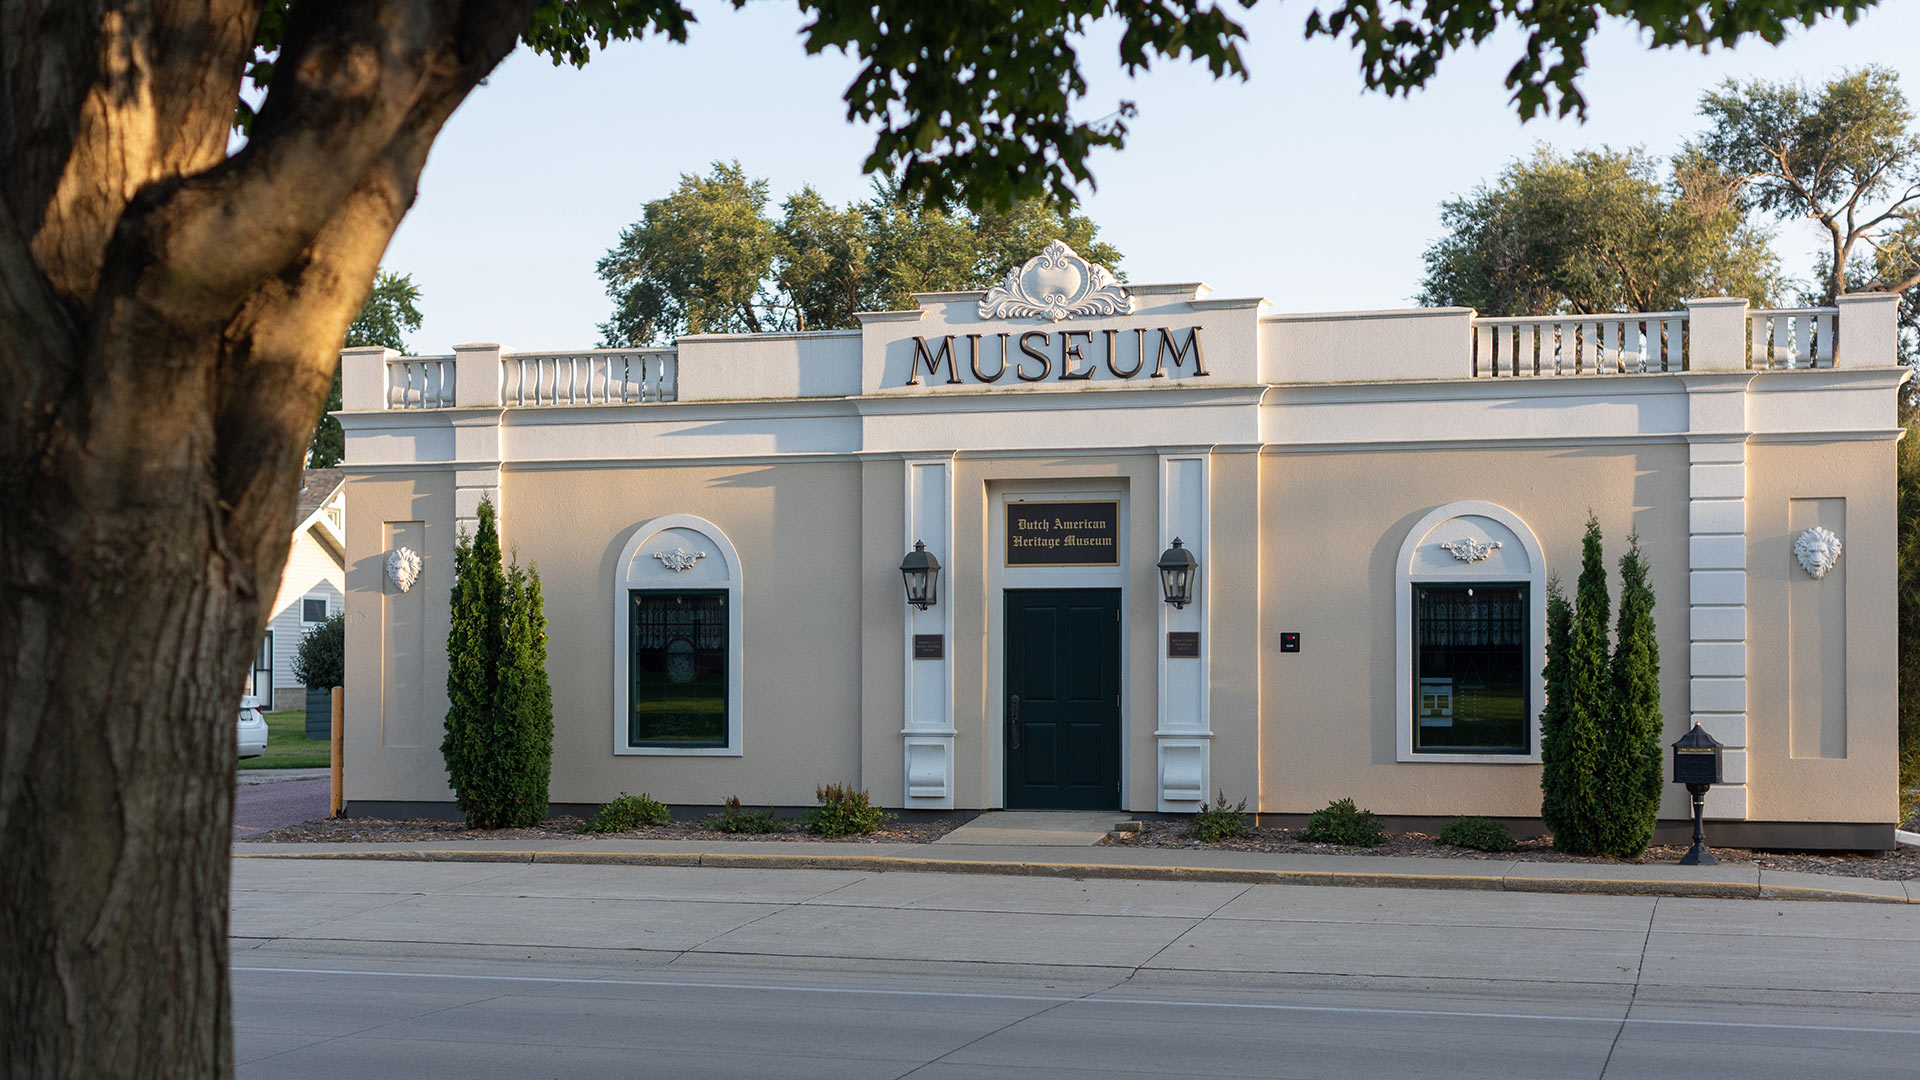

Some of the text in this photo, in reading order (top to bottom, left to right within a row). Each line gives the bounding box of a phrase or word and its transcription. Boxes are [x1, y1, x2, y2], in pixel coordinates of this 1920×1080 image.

[906, 325, 1210, 385] MUSEUM
[1017, 518, 1106, 532] Dutch American
[1012, 535, 1112, 548] Heritage Museum
